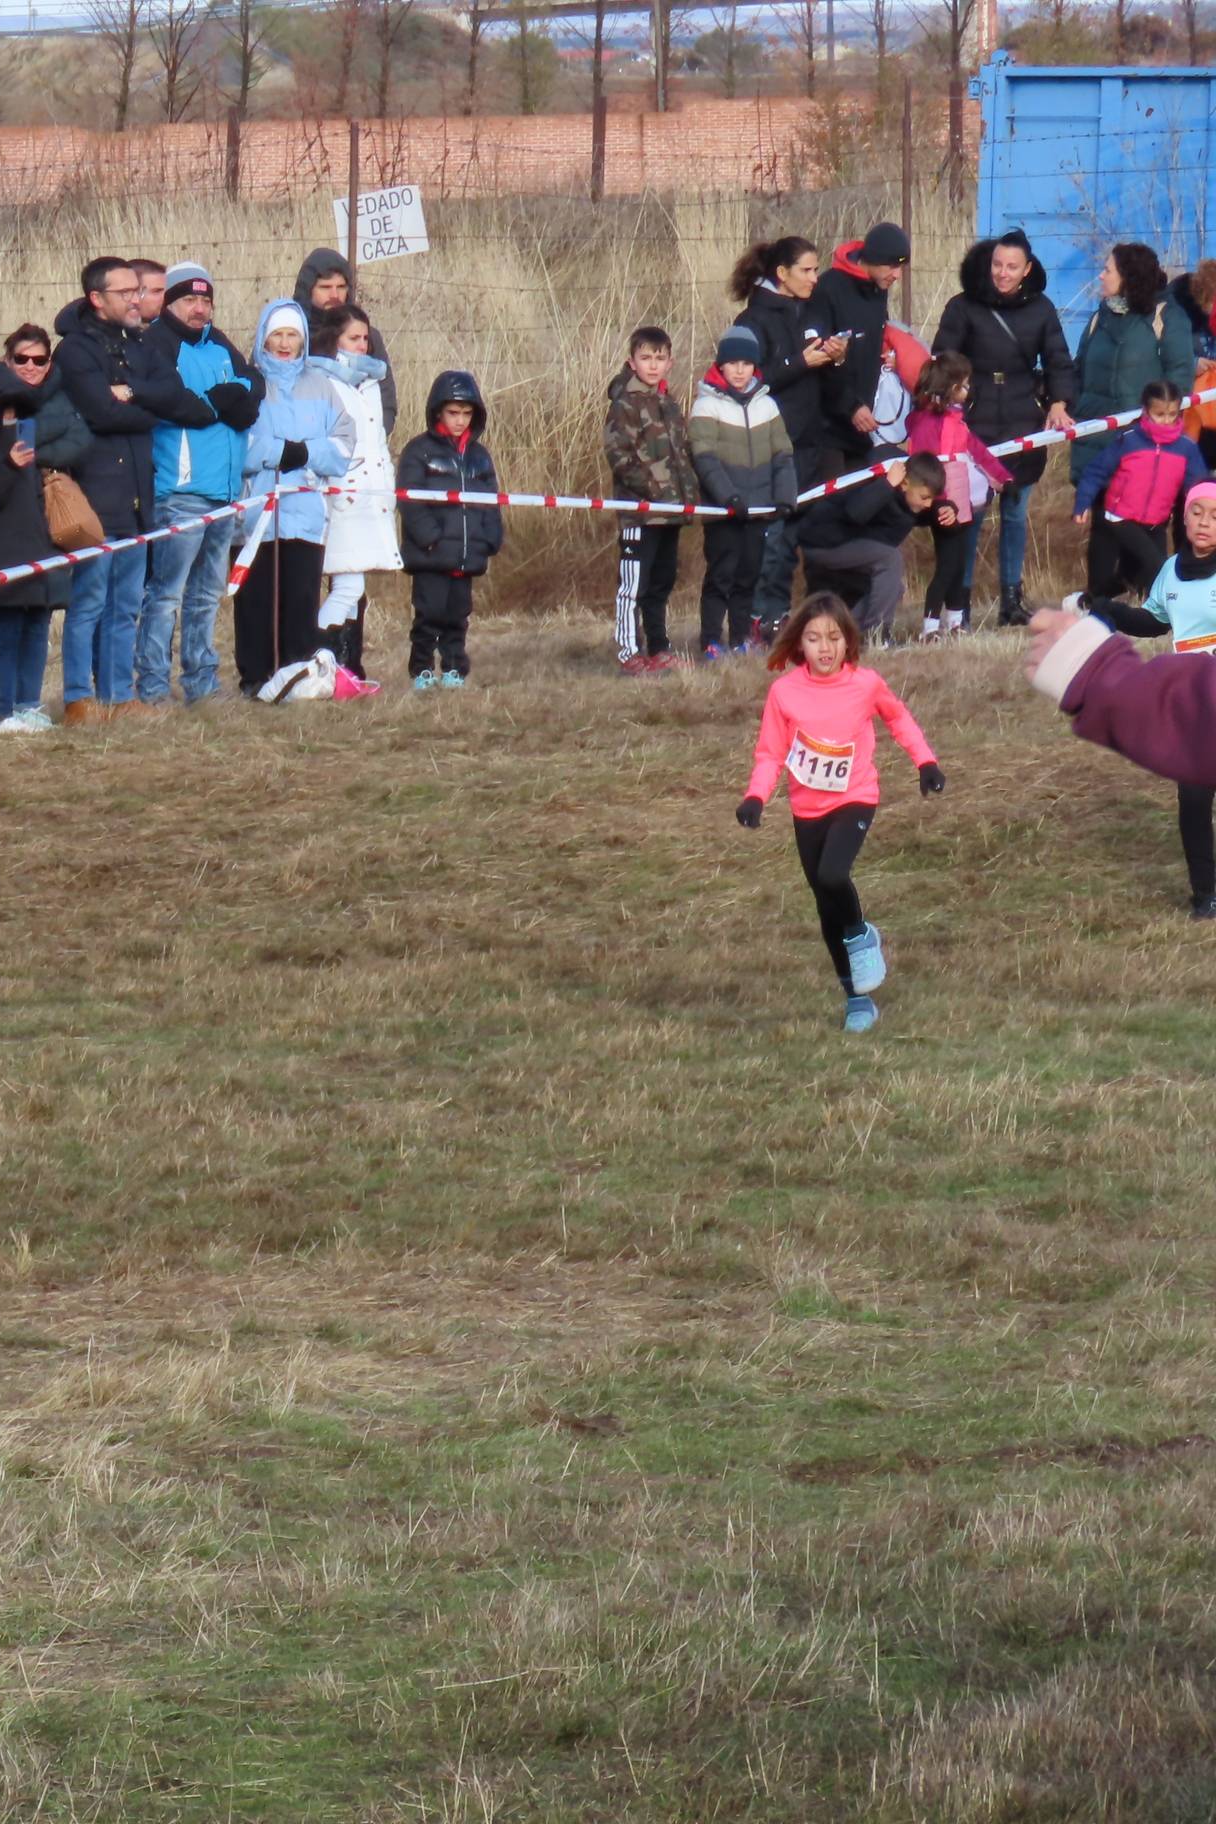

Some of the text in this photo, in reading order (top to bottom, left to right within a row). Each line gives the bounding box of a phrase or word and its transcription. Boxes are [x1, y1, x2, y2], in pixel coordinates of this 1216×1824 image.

[370, 215, 393, 236] DE
[362, 235, 409, 260] CAZA
[798, 750, 849, 778] 1116
